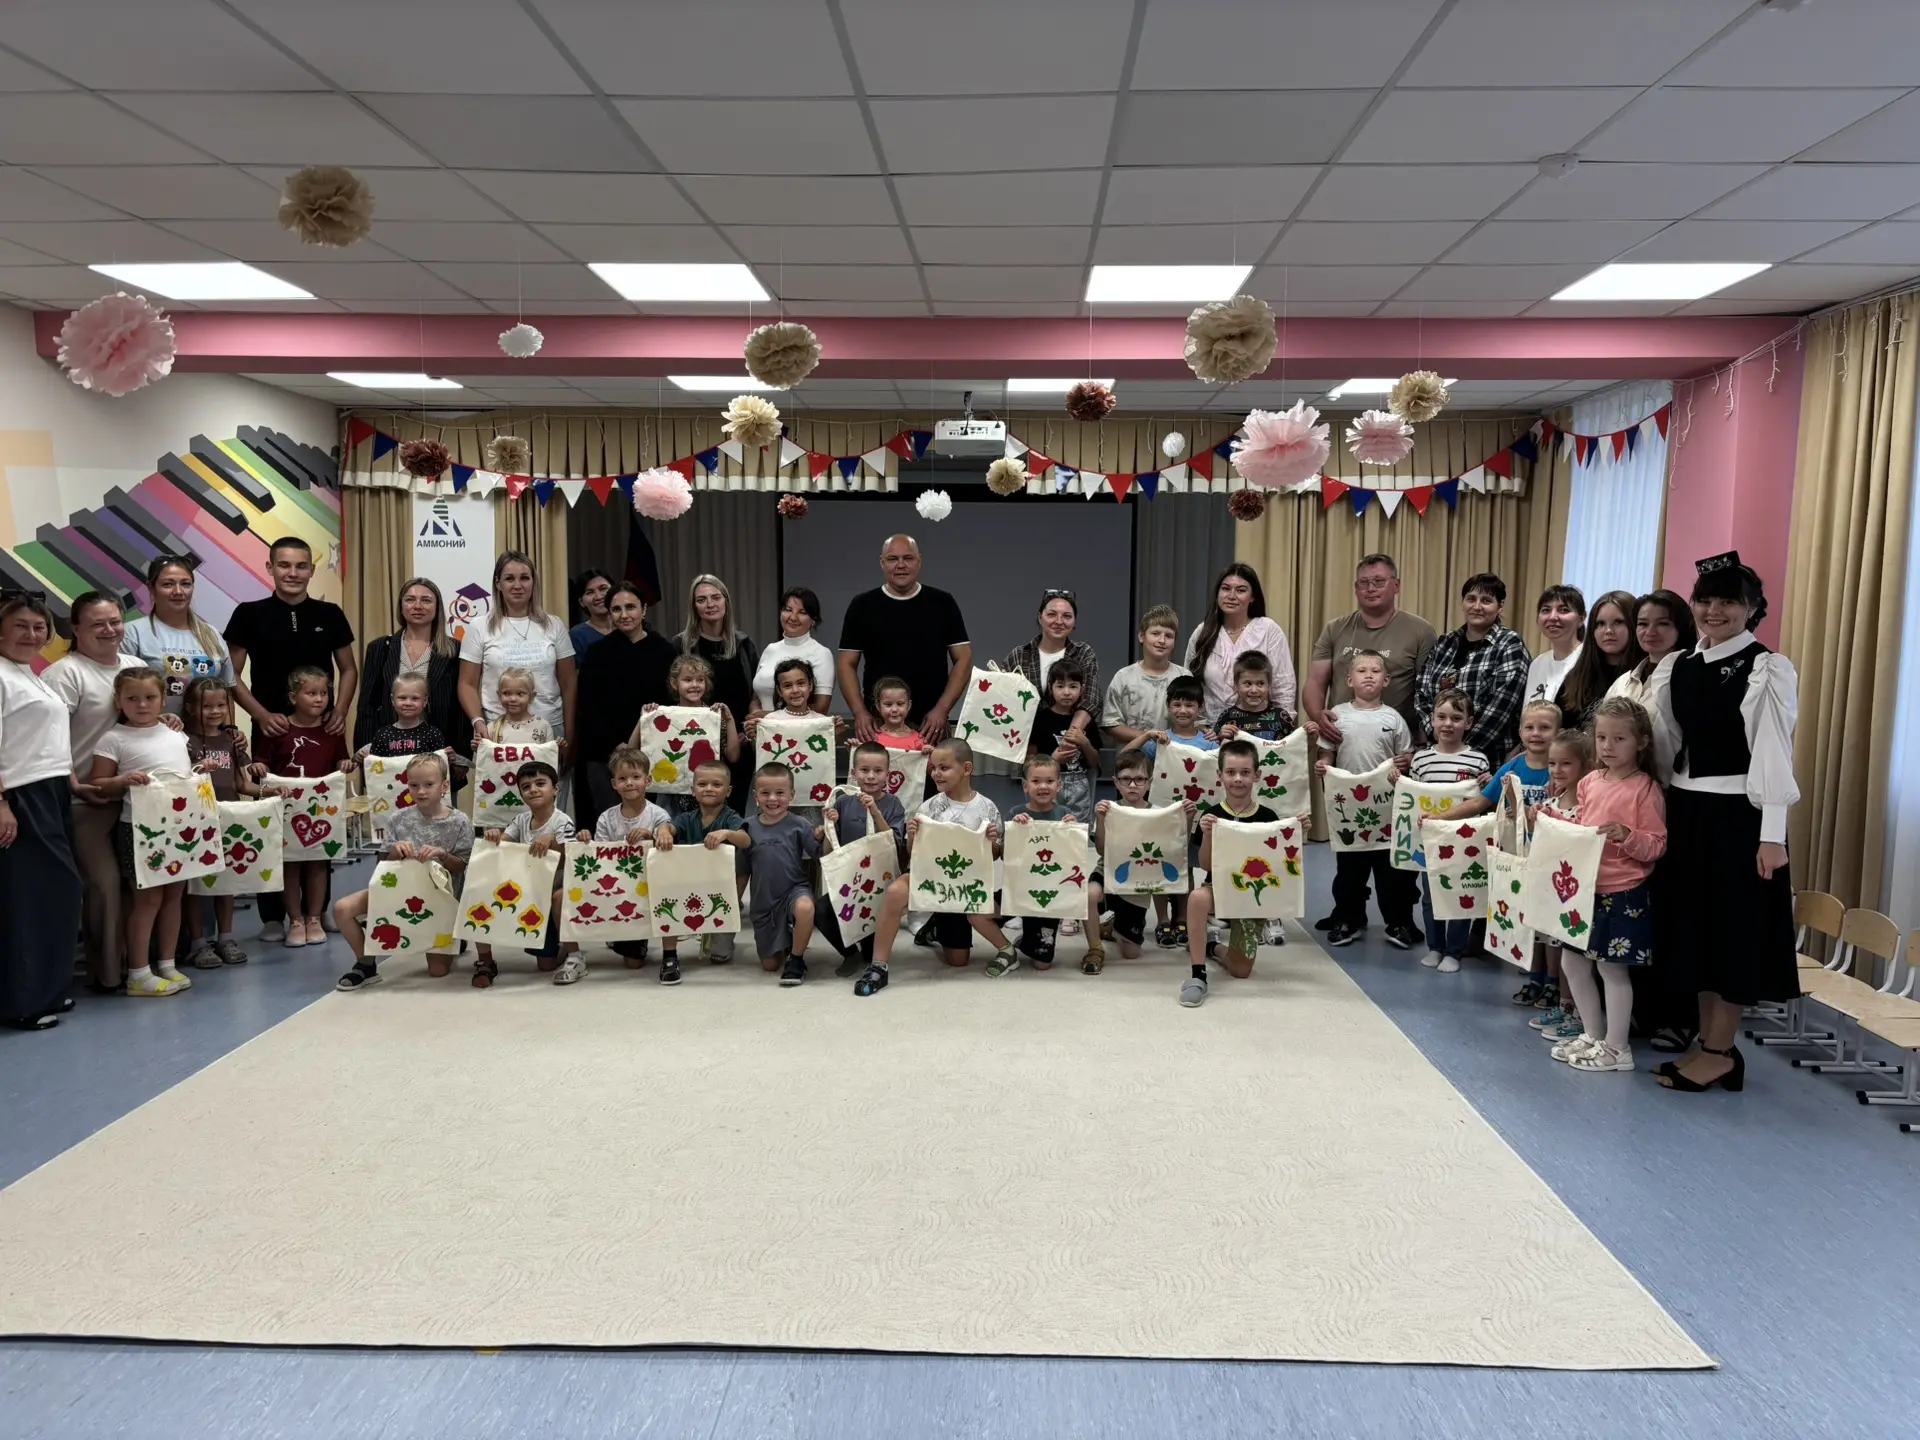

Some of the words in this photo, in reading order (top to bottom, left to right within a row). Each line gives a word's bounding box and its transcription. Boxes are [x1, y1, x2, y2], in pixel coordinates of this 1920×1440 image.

[416, 538, 466, 548] АММОНИЙ
[493, 746, 536, 763] ЕВА
[1395, 792, 1415, 867] ЭМИР
[1028, 835, 1050, 844] АЗАТ
[596, 845, 644, 861] КАРИМ
